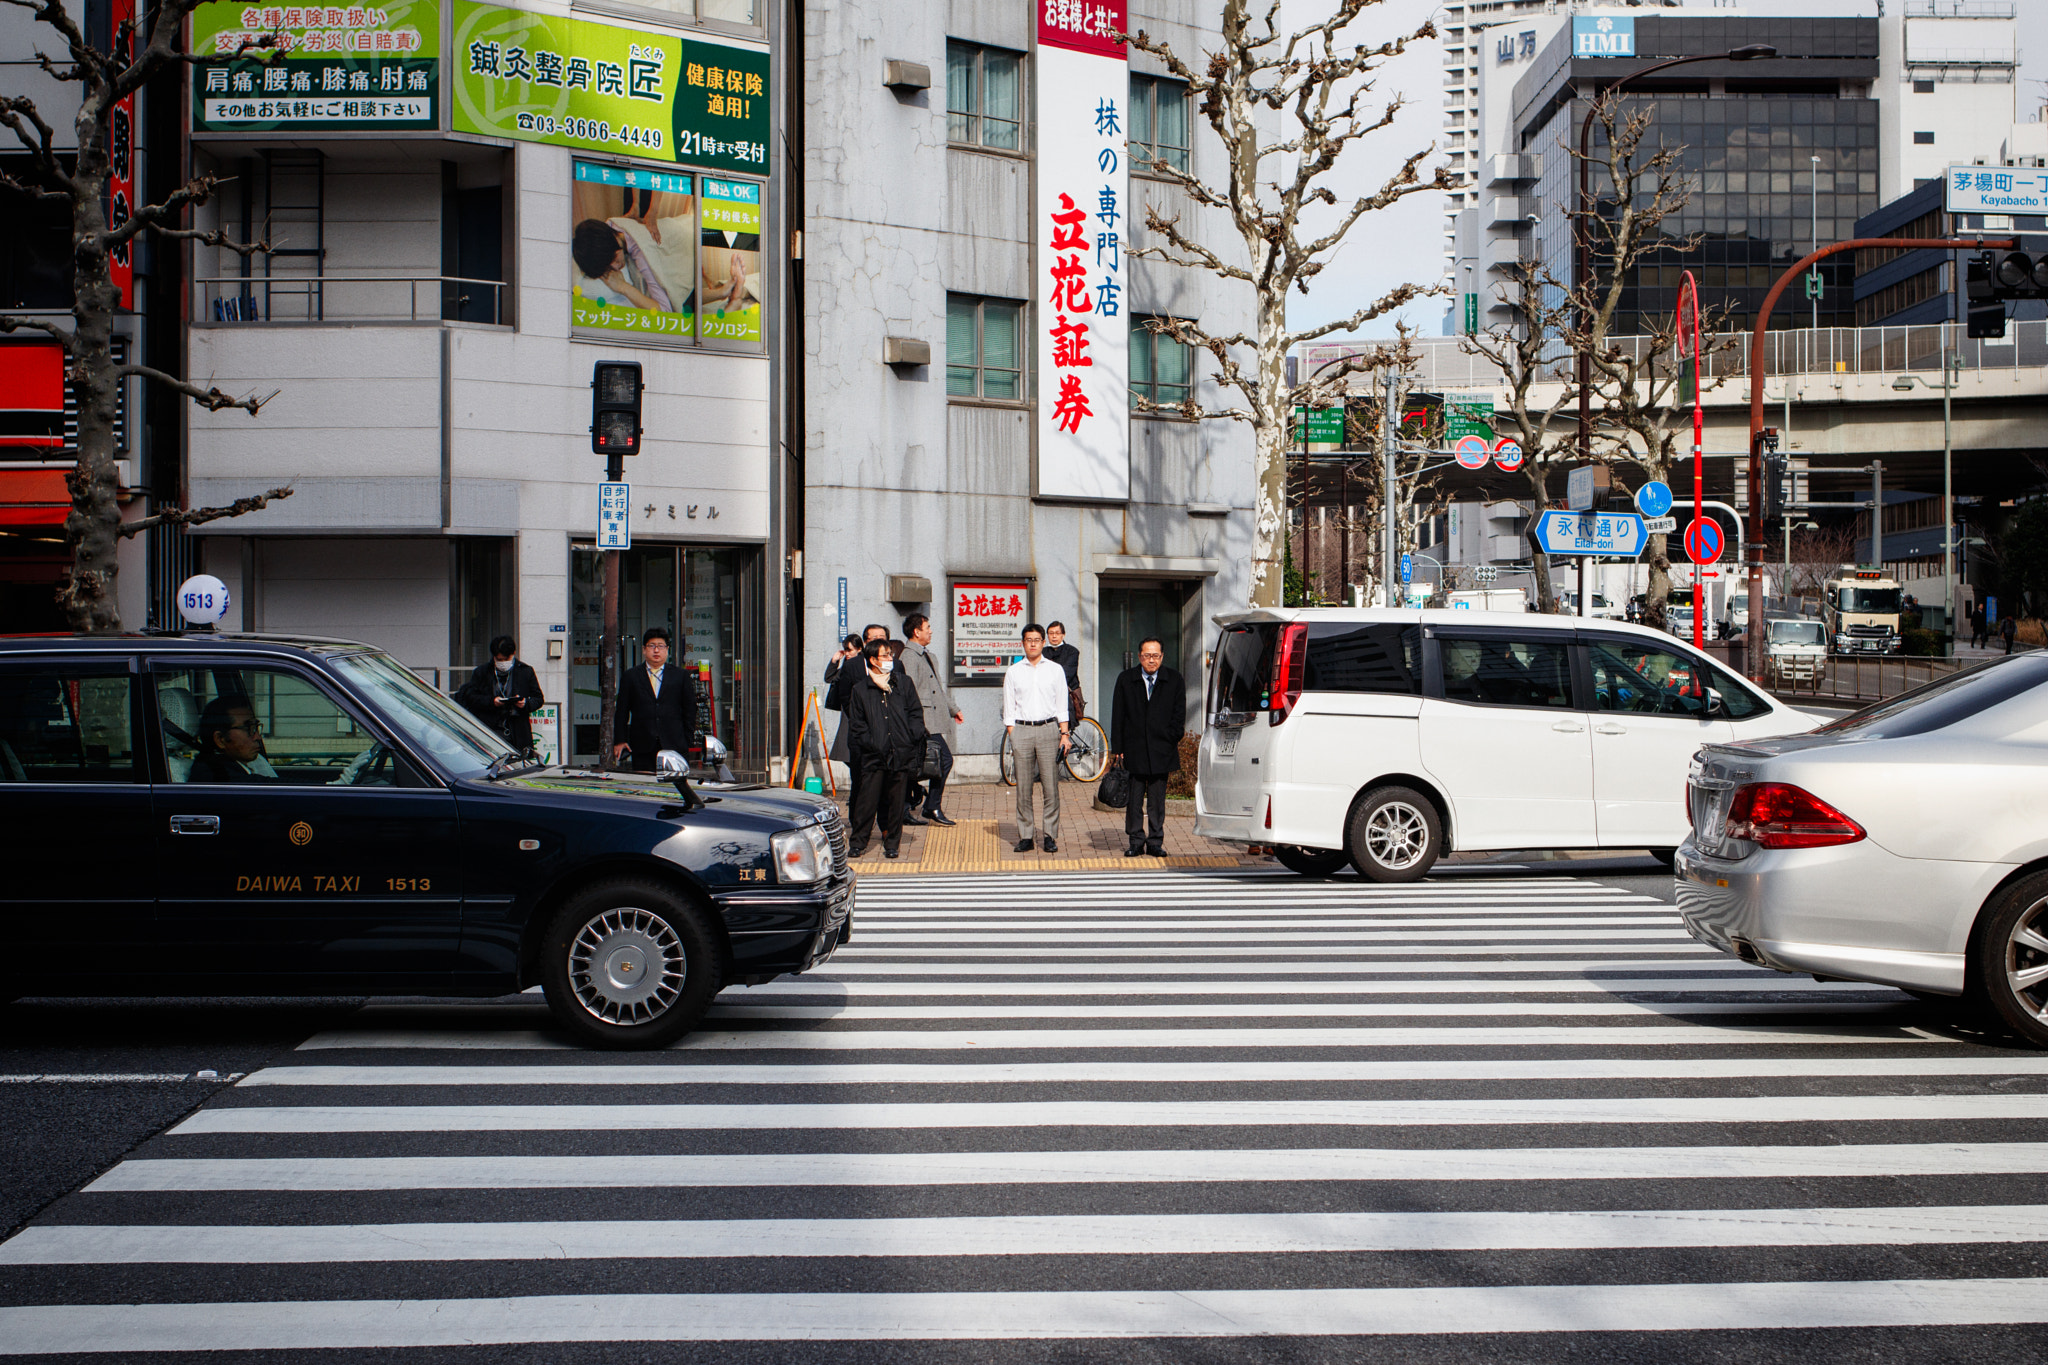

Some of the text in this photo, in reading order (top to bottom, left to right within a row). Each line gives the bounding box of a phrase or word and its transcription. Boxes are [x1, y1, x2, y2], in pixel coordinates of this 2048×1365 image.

[243, 8, 387, 28] 各種保険取扱い
[1045, 0, 1118, 38] お客様と共に
[629, 44, 665, 60] たくみ
[1497, 30, 1537, 62] 山万
[1578, 33, 1631, 53] HMI
[205, 66, 429, 92] 肩痛・腰痛・膝痛・肘痛
[686, 62, 763, 97] 健康保険
[215, 101, 421, 118] その他お気軽にご相談下さい
[707, 93, 750, 120] 適用！
[536, 115, 663, 150] 03-3666-4449
[680, 130, 765, 164] 21時まで受付
[708, 181, 751, 199] 飛込 OK
[1981, 194, 2039, 207] Kayabacho
[1095, 96, 1121, 318] 株の専門店
[574, 310, 637, 328] マッサージ
[641, 316, 650, 329] &
[1049, 191, 1094, 435] 立花証券
[1501, 446, 1520, 462] 50
[602, 486, 613, 521] 自転車
[614, 486, 625, 521] 歩行者
[607, 522, 619, 545] 専用
[1557, 517, 1630, 538] 永代通り
[1574, 537, 1614, 549] Eitai-dori
[184, 592, 213, 609] 1513
[957, 593, 1024, 618] 立花証券
[236, 875, 431, 892] DAIWA TAXI 1513
[739, 868, 767, 882] 江東
